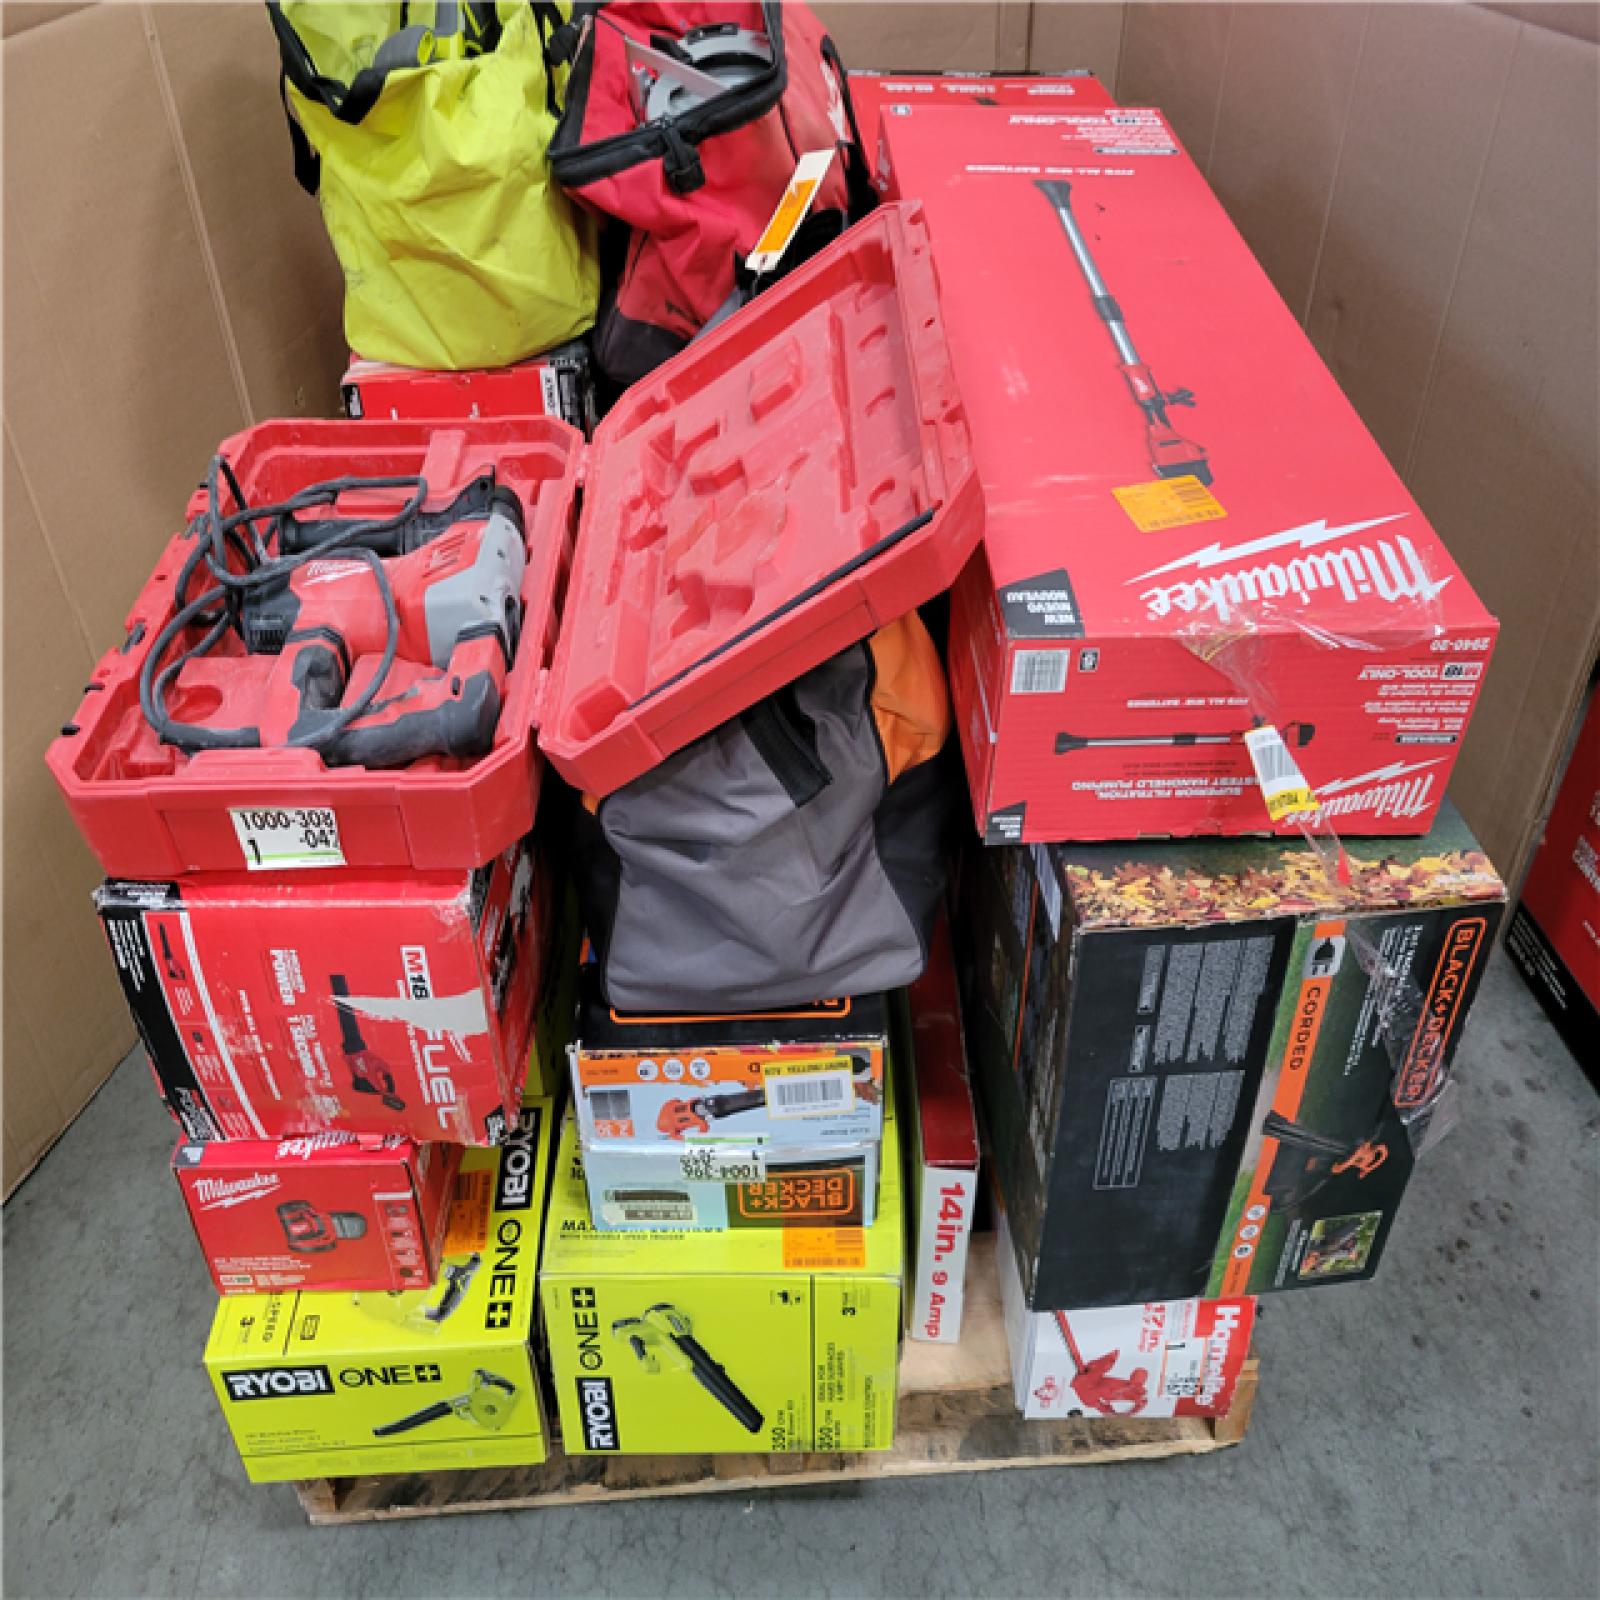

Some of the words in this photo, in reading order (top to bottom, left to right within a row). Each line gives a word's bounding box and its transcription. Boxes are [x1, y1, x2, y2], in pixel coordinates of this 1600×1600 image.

[1139, 534, 1447, 623] Milwaukee
[247, 838, 261, 865] 1
[1288, 985, 1322, 1072] CORDED
[1396, 924, 1479, 1103] BLACK+DECKER
[193, 1173, 278, 1201] Milwaukee
[748, 1176, 843, 1195] DECKER
[932, 1271, 948, 1286] 9
[571, 1288, 603, 1370] ONE+
[842, 1307, 856, 1316] 3
[925, 1292, 946, 1338] Amp
[228, 1369, 327, 1397] RYOBI
[340, 1364, 441, 1387] ONE+
[582, 1380, 611, 1448] RYOBI
